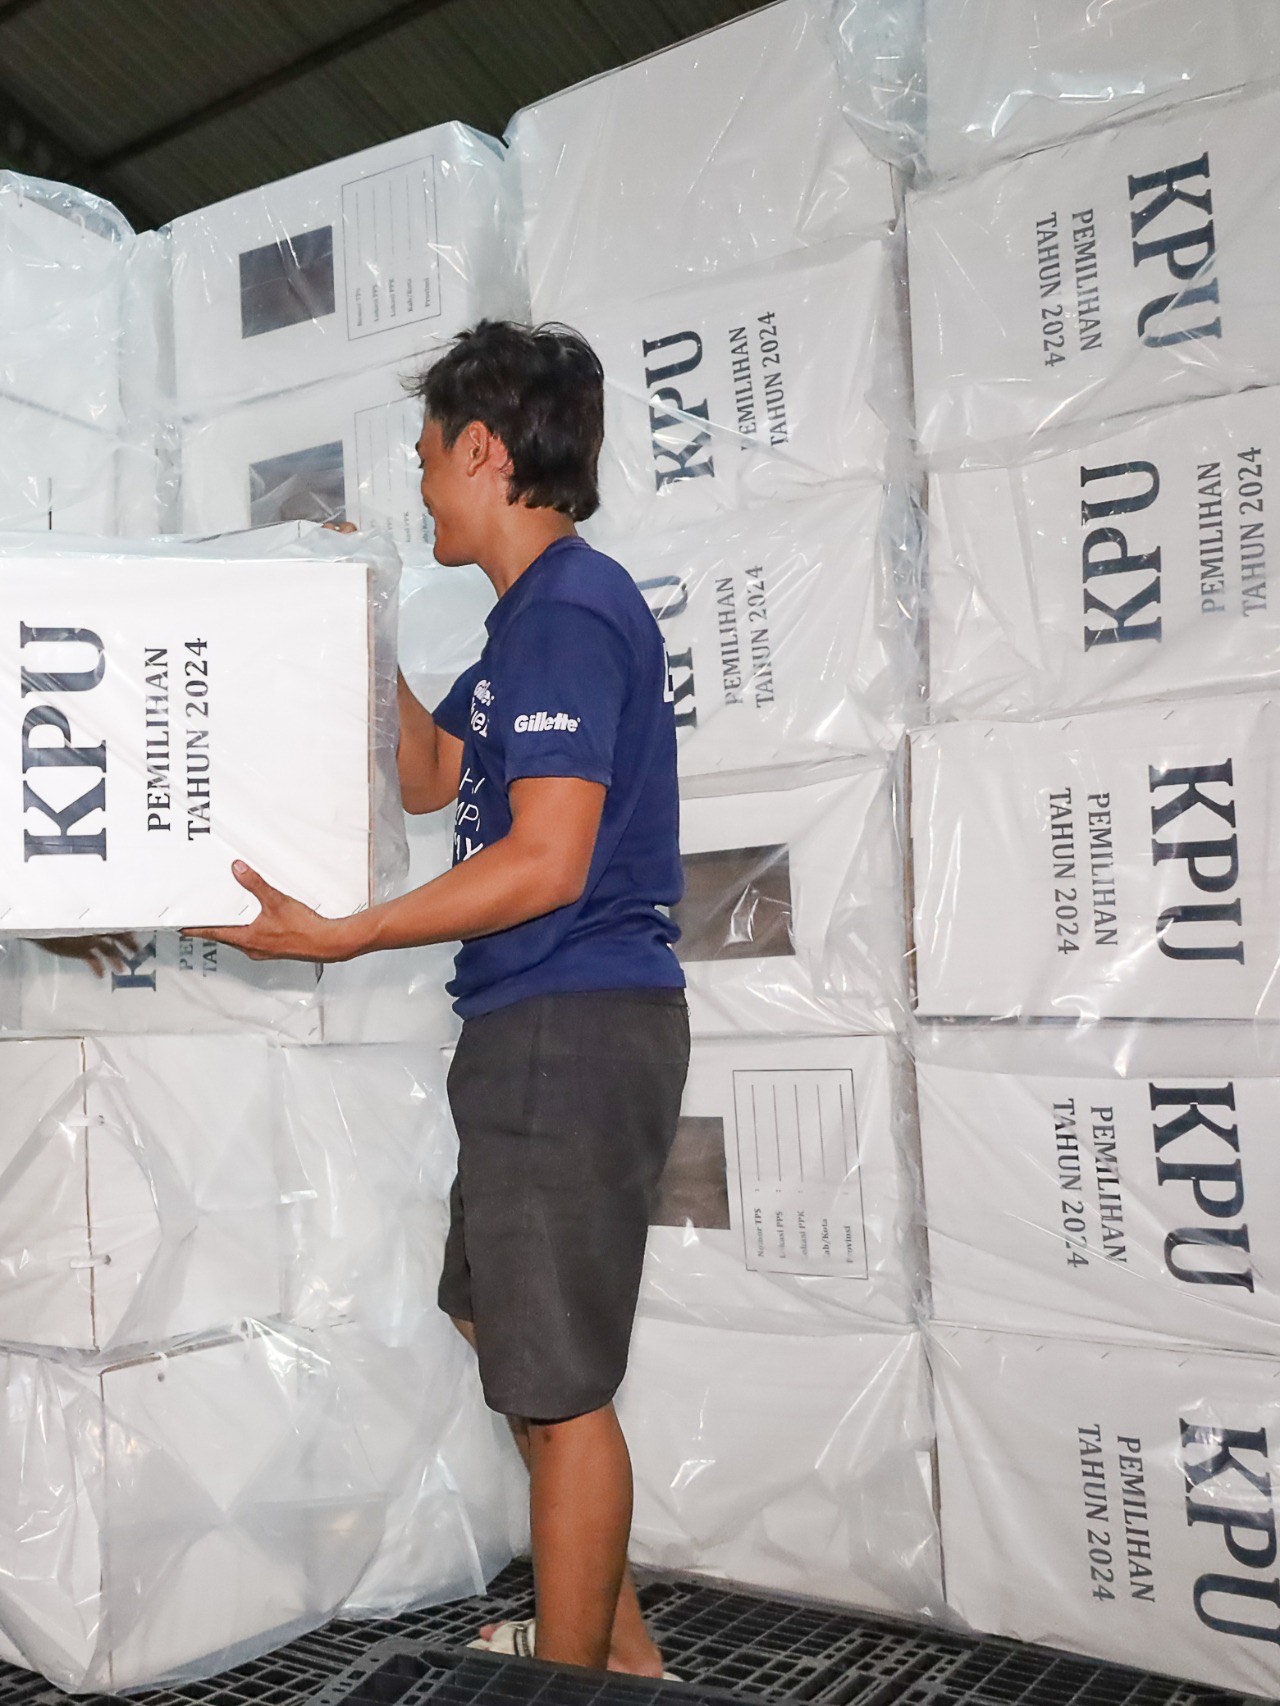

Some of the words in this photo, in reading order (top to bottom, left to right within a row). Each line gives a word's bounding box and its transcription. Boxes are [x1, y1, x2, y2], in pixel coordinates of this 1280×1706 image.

[1035, 211, 1062, 297] TAHUN
[1071, 208, 1103, 351] PEMILIHAN
[1127, 151, 1223, 349] KPU
[757, 311, 781, 368] 2024
[1040, 304, 1066, 367] 2024
[642, 331, 715, 492] KPU
[728, 326, 758, 451] EMILIHAN
[763, 372, 789, 447] TAHUN
[1237, 446, 1264, 518] 2024
[1080, 460, 1162, 653] KPU
[1197, 462, 1226, 615] PEMILIHAN
[1239, 523, 1268, 618] TAHUN
[745, 565, 768, 622] 2024
[184, 637, 210, 717] 2024
[715, 577, 743, 706] PEMILIHAN
[750, 628, 775, 709] TAHUN
[20, 620, 107, 863] KPU
[144, 647, 172, 833] PEMILIHAN
[514, 711, 580, 733] Gillette
[184, 729, 211, 841] TAHUN
[1049, 787, 1077, 881] TAHUN
[1087, 792, 1118, 947] PEMILIHAN
[1148, 757, 1245, 966] KPU
[1053, 887, 1080, 955] 2024
[1052, 1098, 1082, 1192] TAHUN
[1090, 1105, 1127, 1264] PEMILIHAN
[1148, 1081, 1255, 1294] KPU
[754, 1208, 762, 1224] TPS
[776, 1210, 784, 1228] PPS
[798, 1210, 806, 1229] PPK
[821, 1218, 831, 1257] ab/Kota
[1061, 1199, 1090, 1268] 2024
[1077, 1423, 1110, 1523] TAHUN
[1117, 1435, 1156, 1603] PEMILIHAN
[1087, 1528, 1116, 1602] 2024
[1179, 1418, 1280, 1647] KPU
